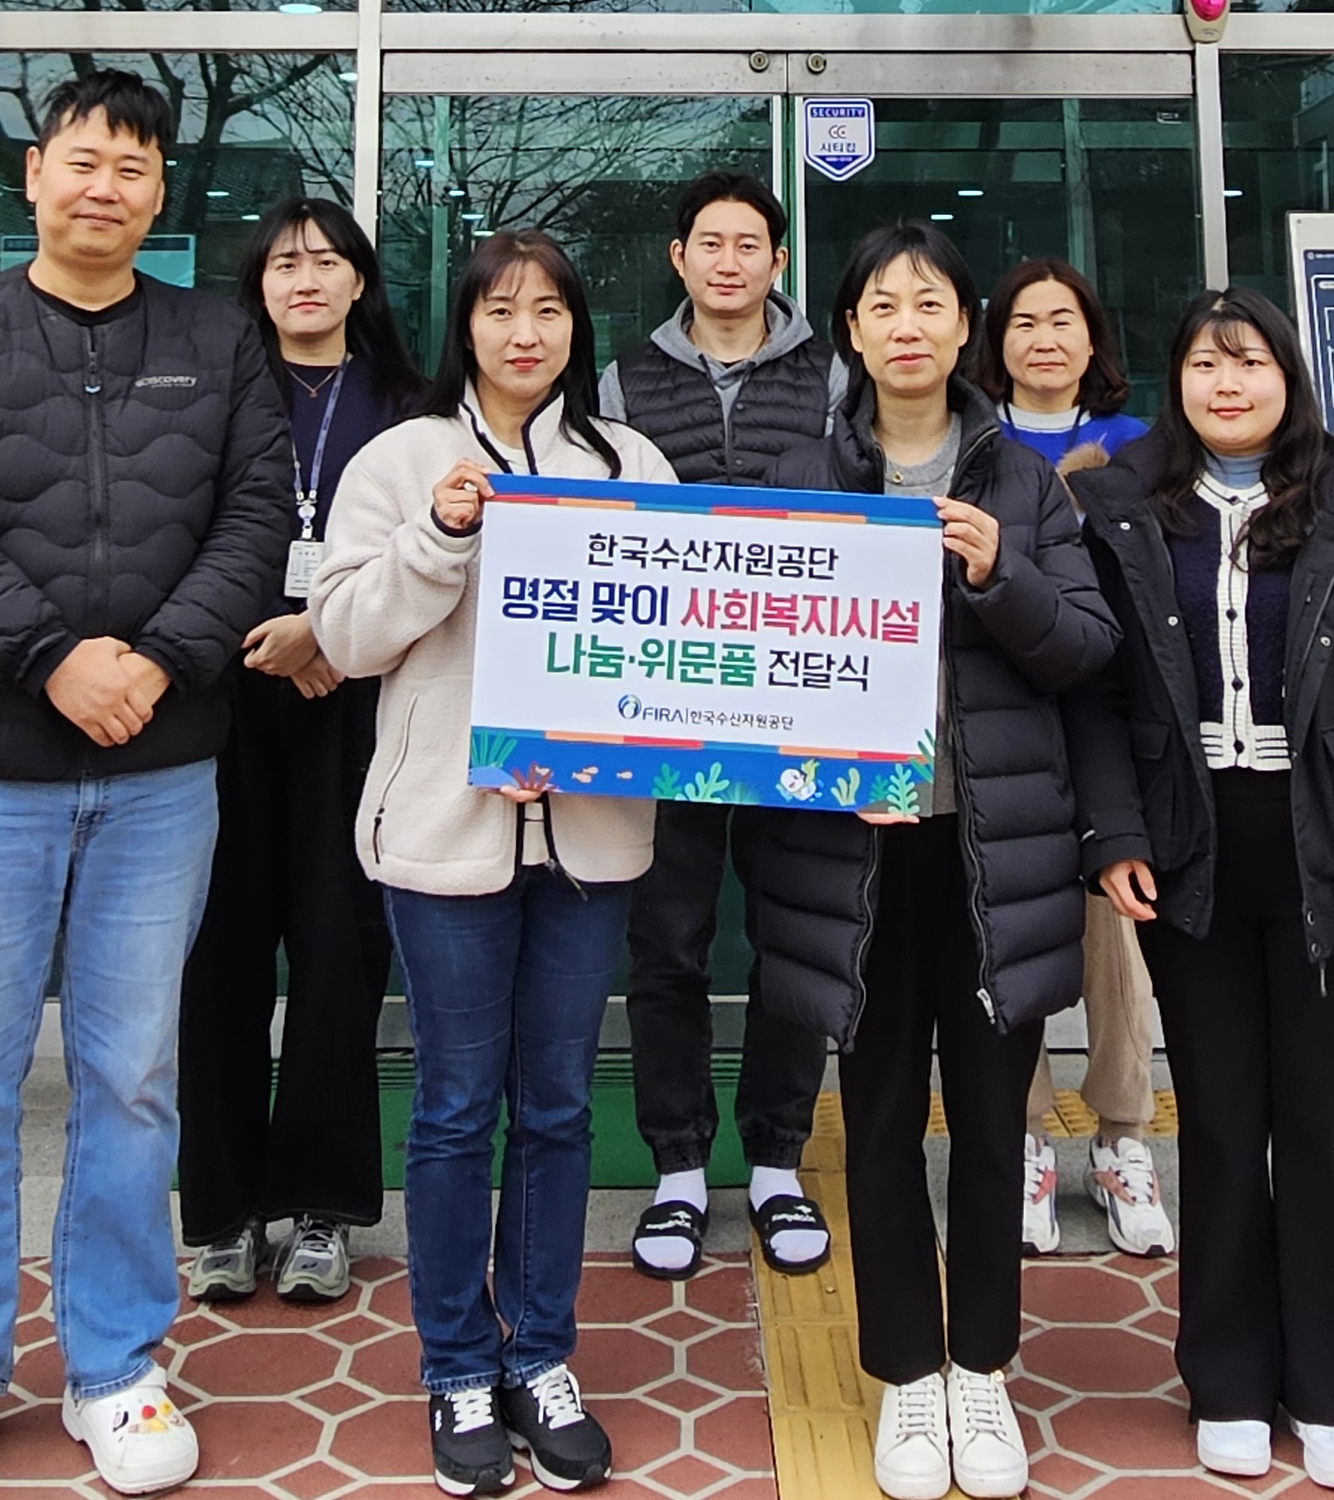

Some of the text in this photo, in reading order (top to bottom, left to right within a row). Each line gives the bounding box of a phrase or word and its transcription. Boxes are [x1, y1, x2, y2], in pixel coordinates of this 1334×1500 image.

[812, 108, 864, 118] SECURITY
[587, 532, 839, 580] 한국수산자원공단
[502, 575, 920, 644] 명절 맞이 사회복지시설
[546, 631, 870, 692] 나눔·위문품 전달식
[642, 707, 795, 731] FIRA 한국수산자원공단
